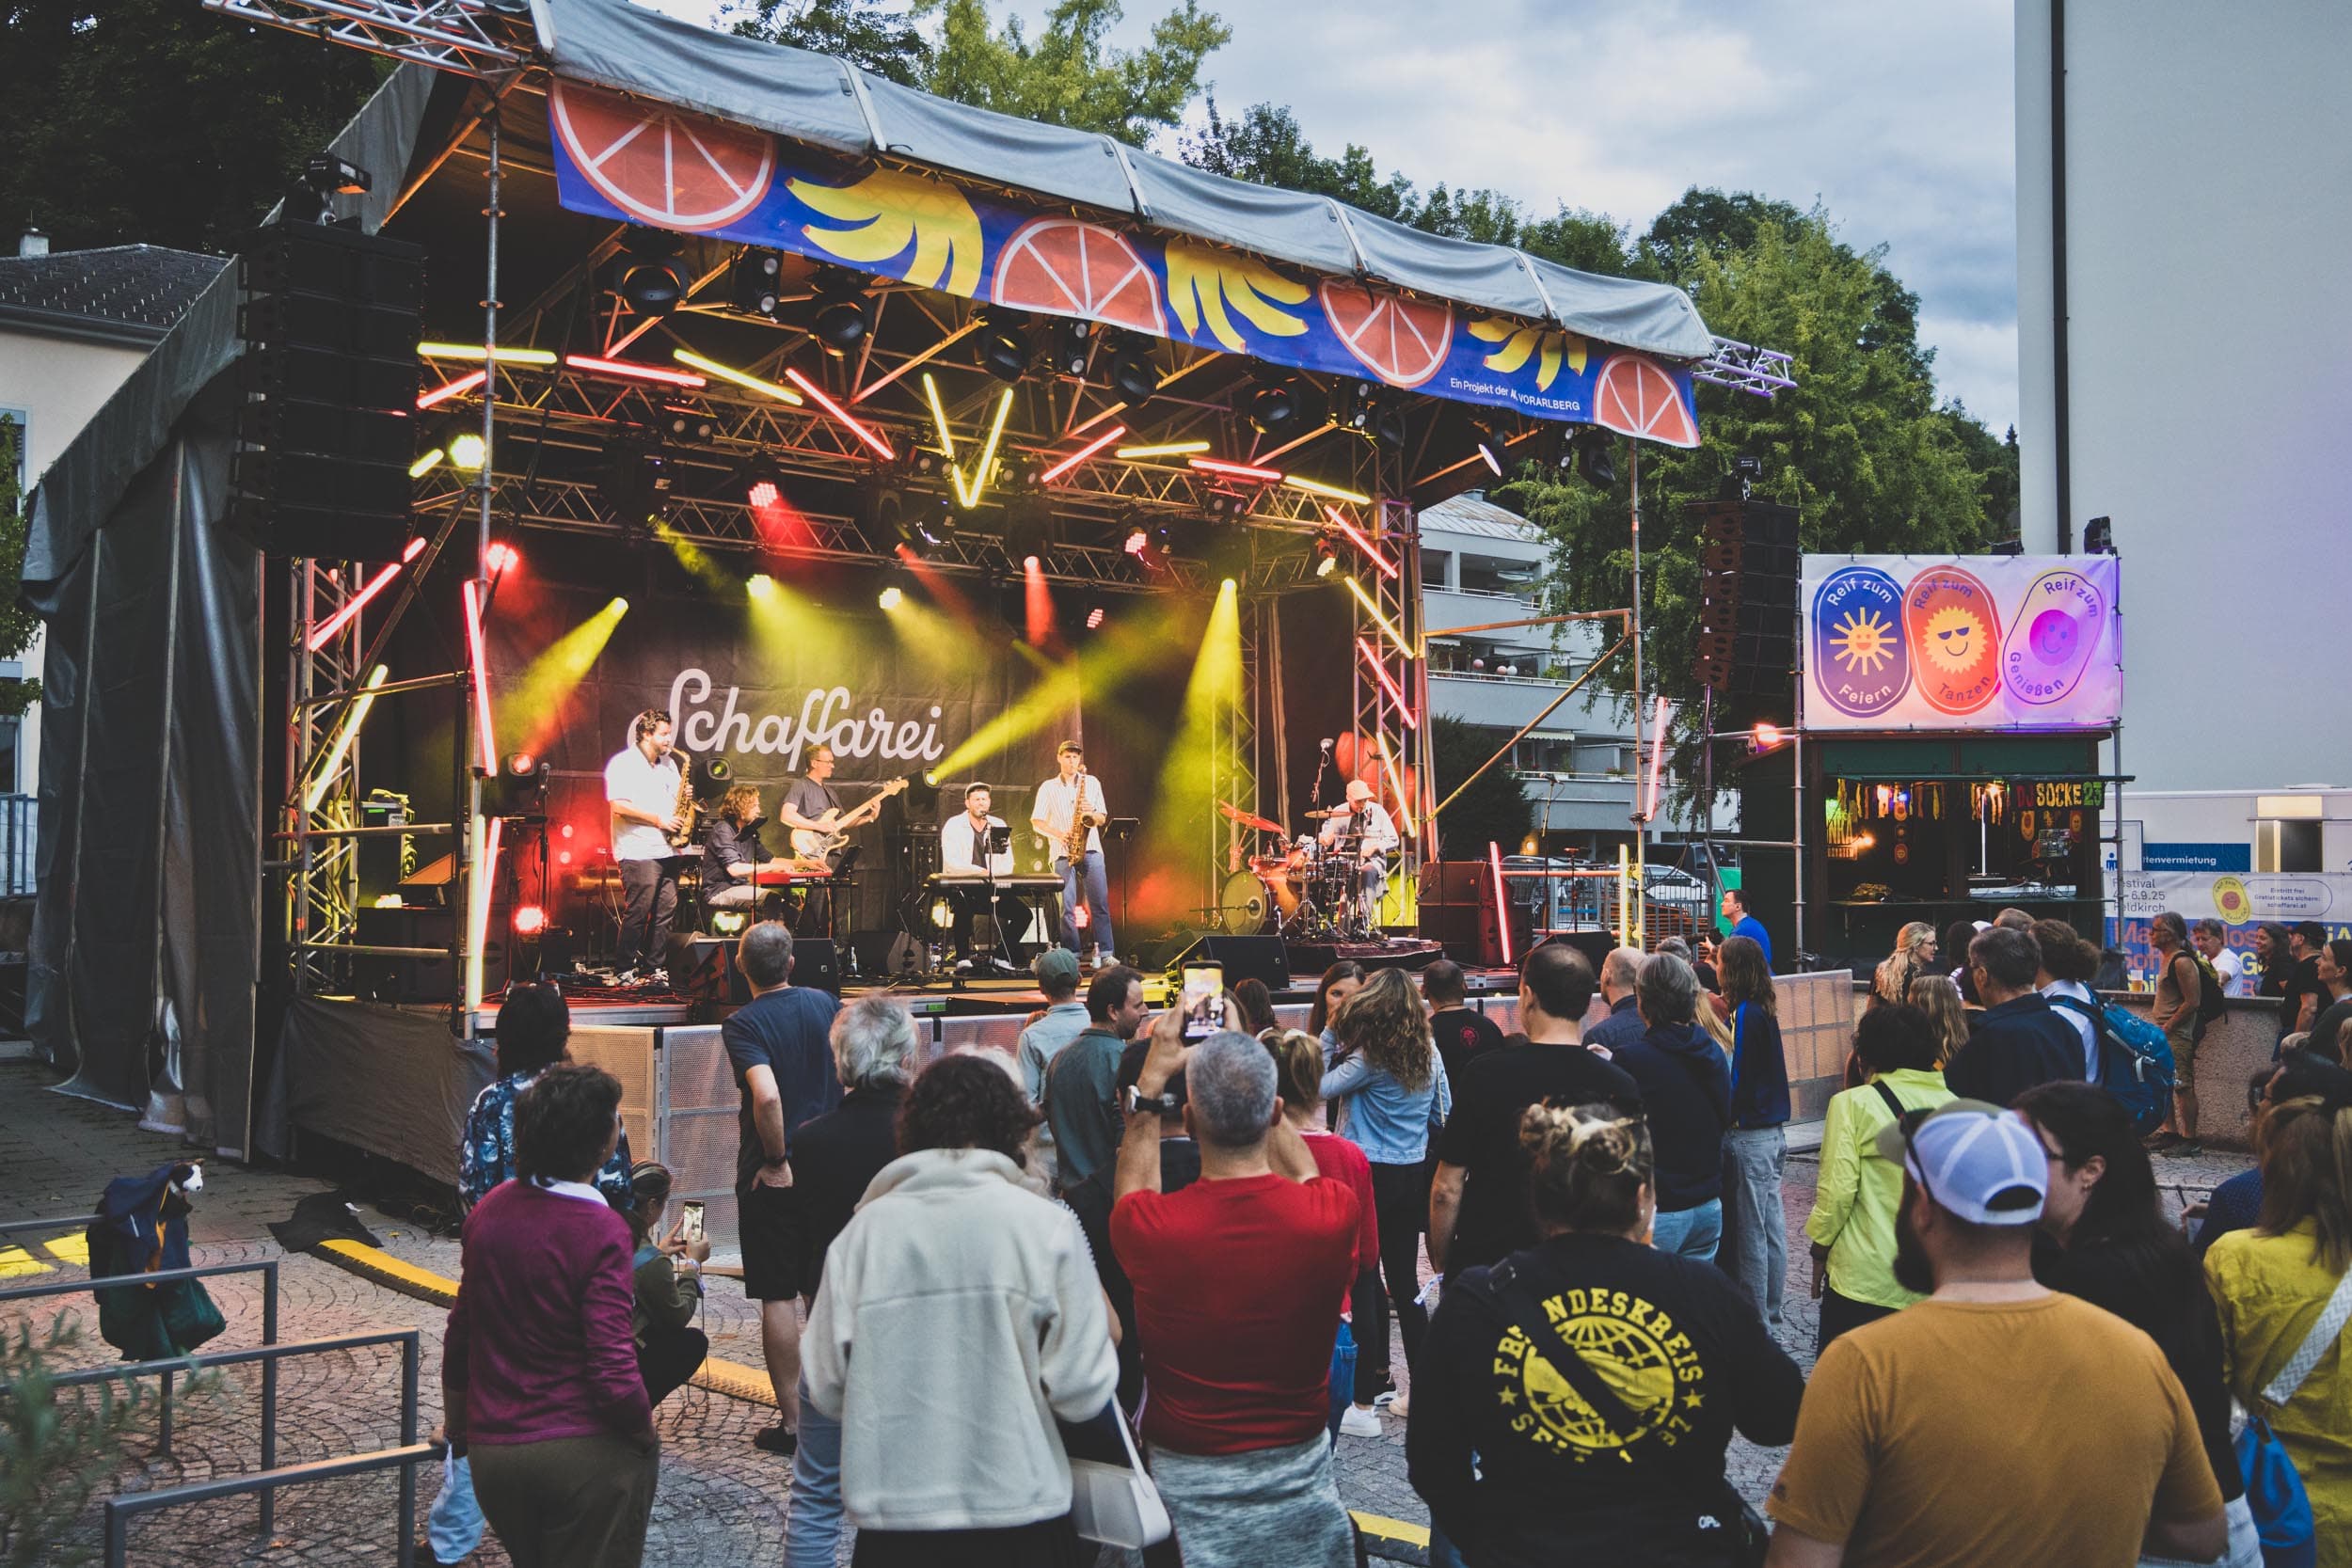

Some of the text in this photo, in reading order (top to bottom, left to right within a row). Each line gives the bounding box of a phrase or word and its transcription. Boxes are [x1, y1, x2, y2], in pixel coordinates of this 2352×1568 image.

[1450, 377, 1462, 388] Ein
[1464, 380, 1494, 395] Projekt
[1495, 385, 1509, 396] der
[1518, 393, 1581, 411] VORARLBERG
[1827, 578, 1893, 607] Reif zum
[1914, 578, 1974, 610] Reif zum
[2043, 578, 2098, 618] Reif zum
[1938, 673, 1992, 703] Tanzen
[2009, 651, 2066, 697] Genießen
[1837, 683, 1893, 705] Feiern
[627, 668, 945, 773] Schaffarei
[2035, 782, 2083, 808] SOCKE
[2112, 878, 2156, 889] Fstival
